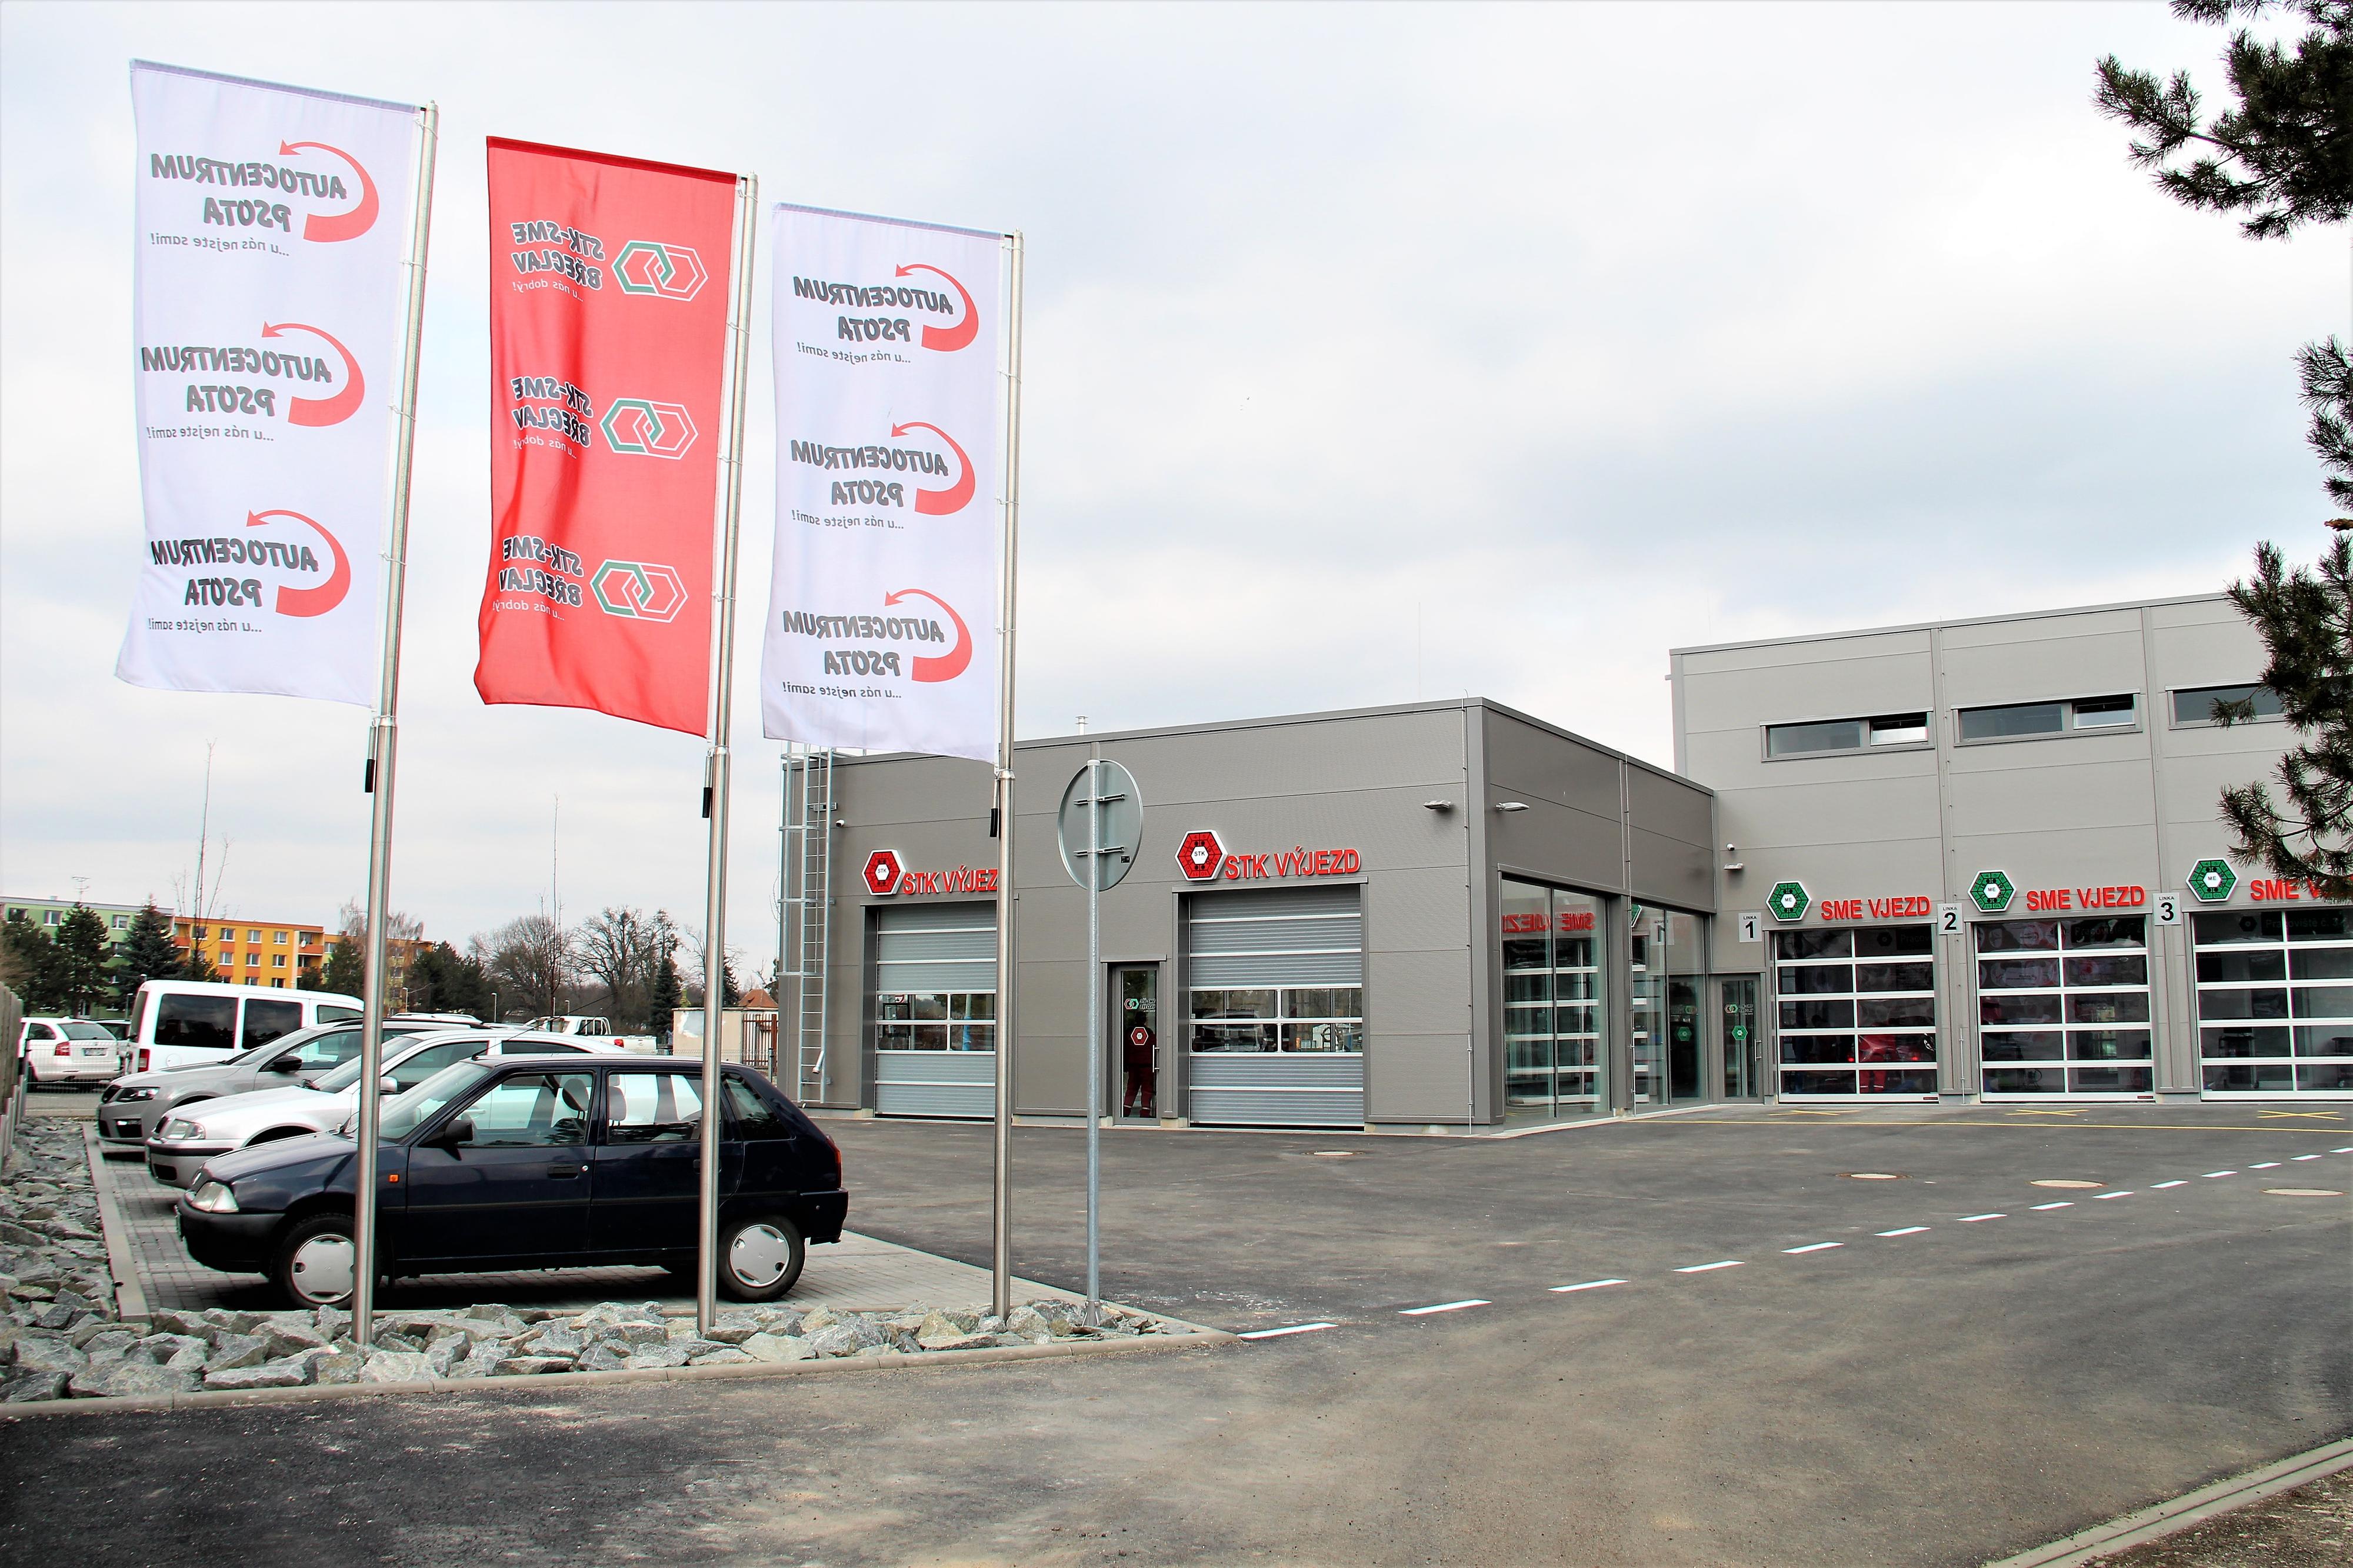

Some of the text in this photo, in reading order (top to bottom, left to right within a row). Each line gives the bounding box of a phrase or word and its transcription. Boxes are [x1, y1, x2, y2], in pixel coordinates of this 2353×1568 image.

[1224, 845, 1361, 879] STK VÝJEZD
[902, 865, 998, 895] STK VÝJEZ
[2250, 878, 2299, 901] SME
[1821, 896, 1931, 920] SME VJEZD
[2027, 885, 2147, 911] SME VJEZD
[1944, 912, 1957, 930] 2
[2161, 902, 2174, 922] 3
[1745, 921, 1755, 939] 1
